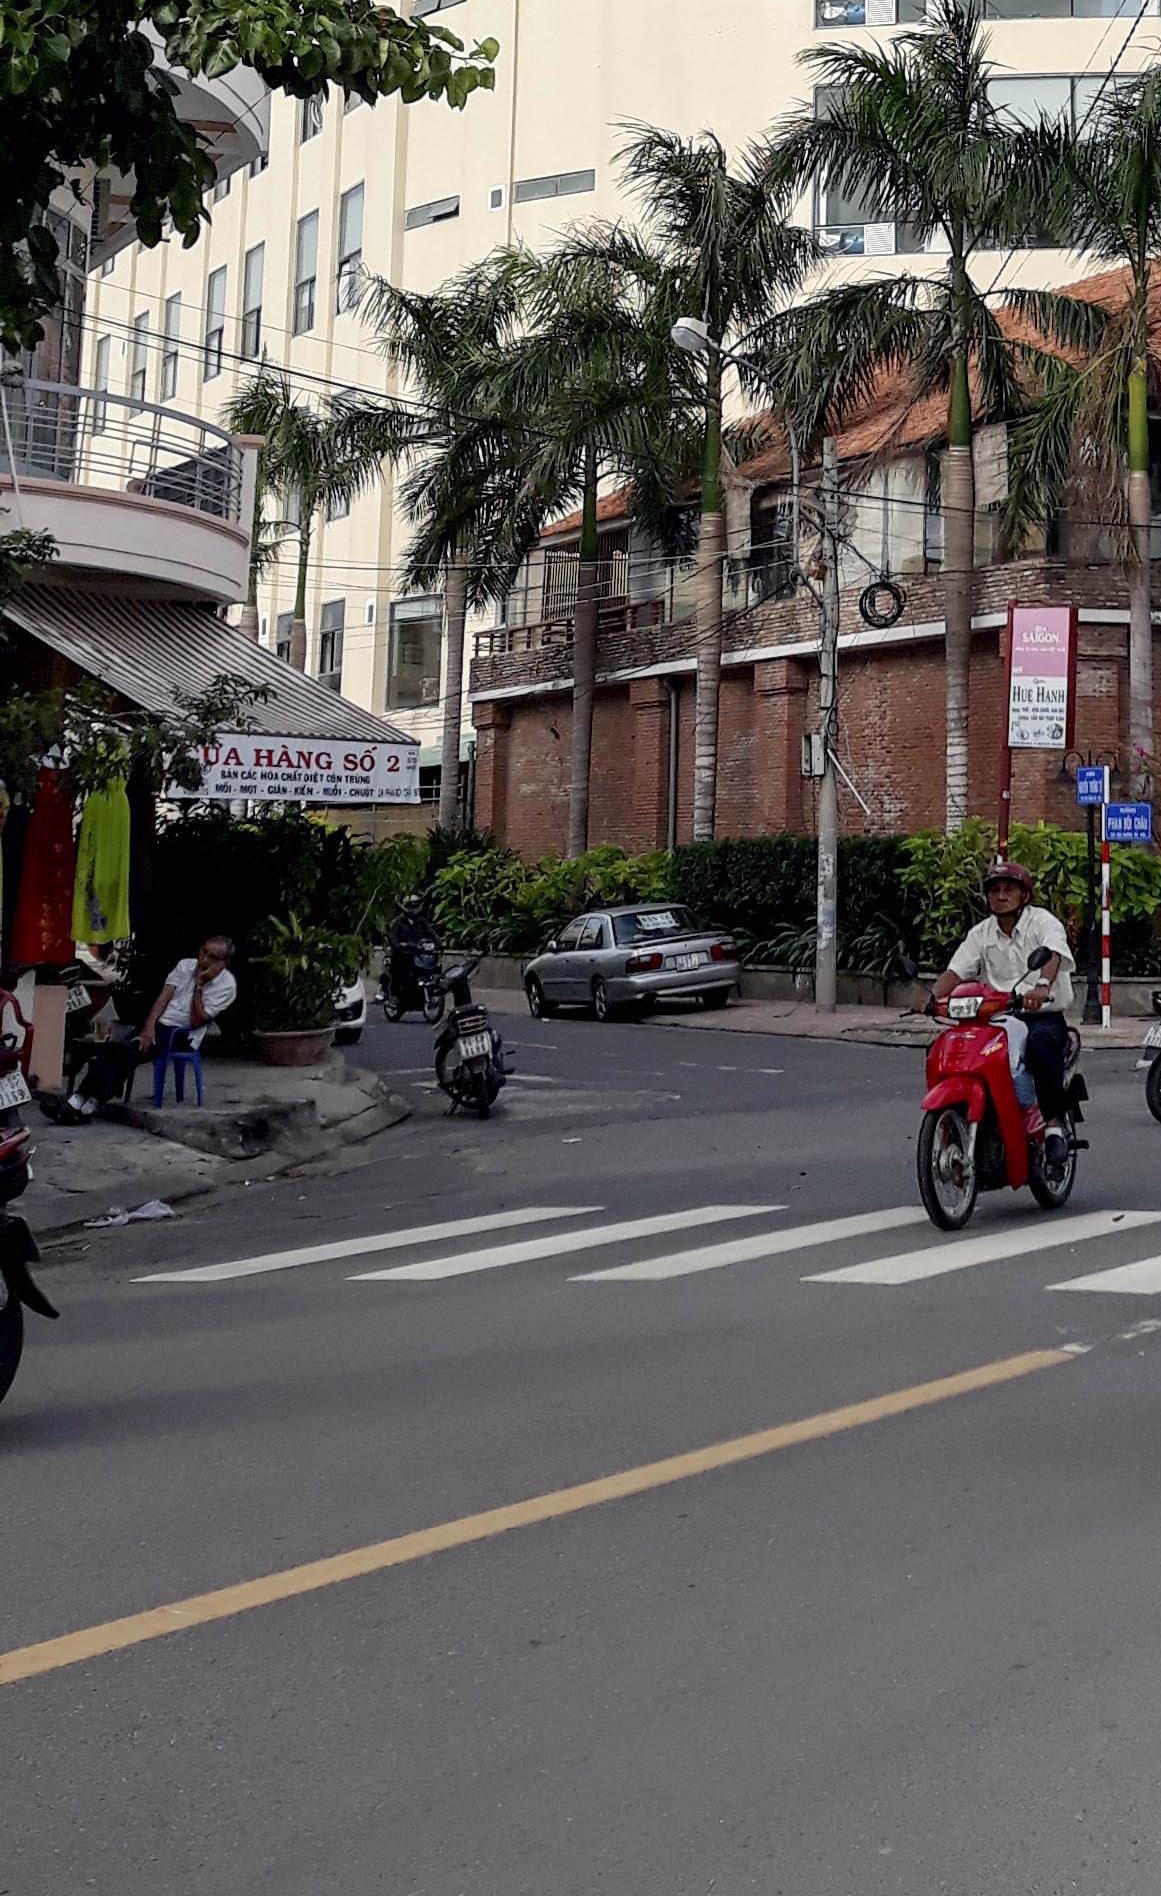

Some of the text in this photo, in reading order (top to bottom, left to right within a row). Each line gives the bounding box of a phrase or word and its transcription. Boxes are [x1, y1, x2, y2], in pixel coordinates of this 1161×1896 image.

[253, 744, 334, 771] HÀNG
[343, 745, 378, 773] SỐ
[386, 755, 400, 773] 2
